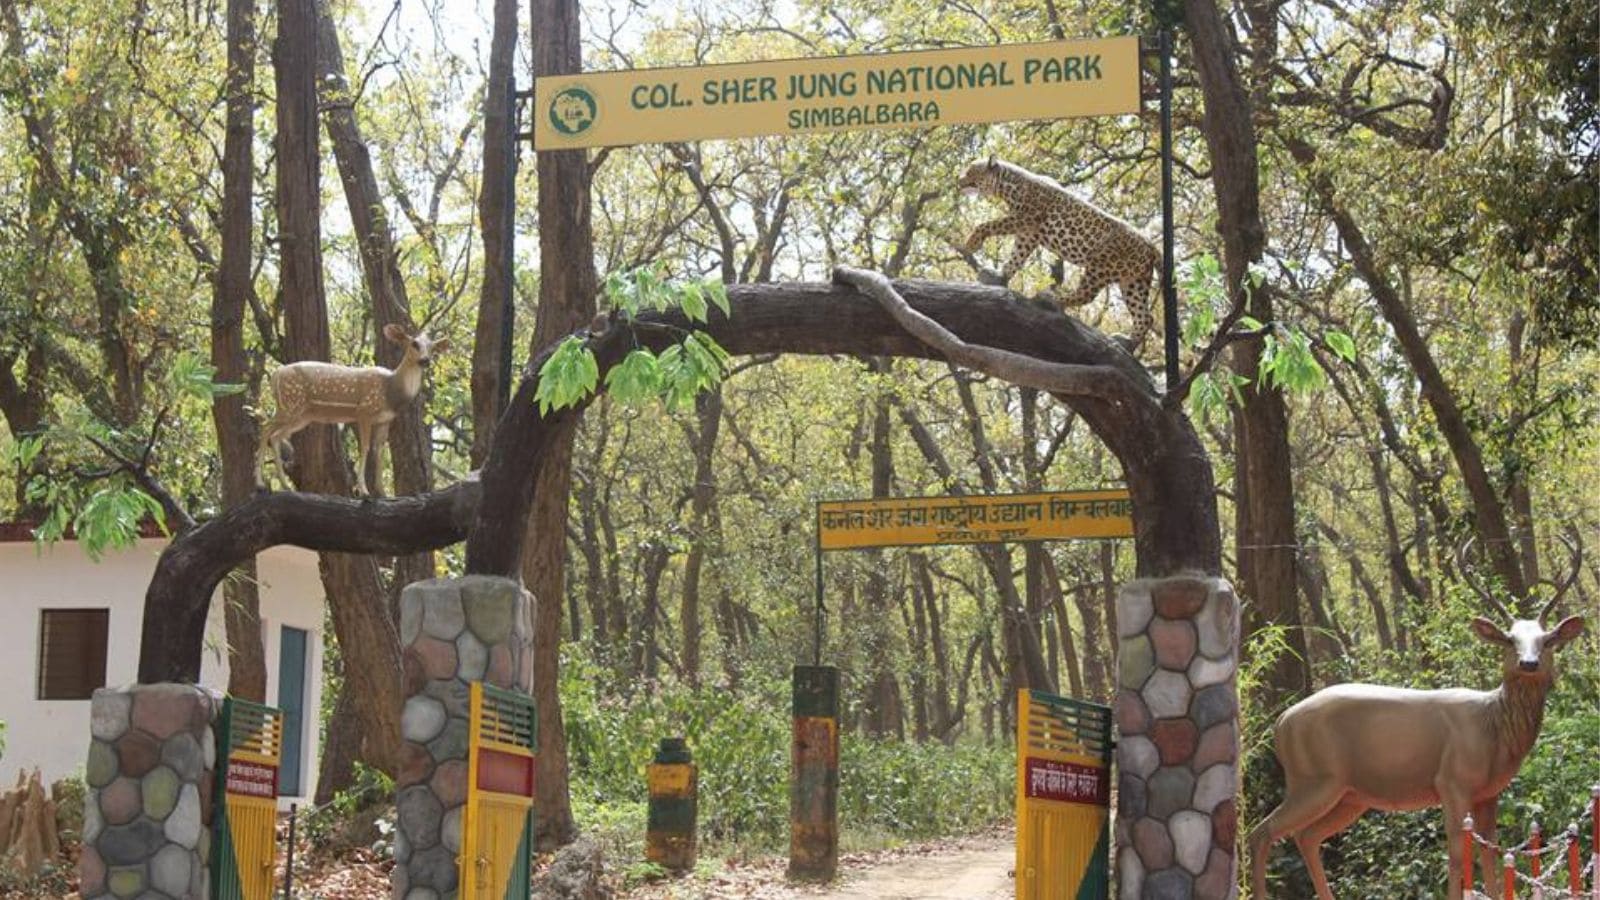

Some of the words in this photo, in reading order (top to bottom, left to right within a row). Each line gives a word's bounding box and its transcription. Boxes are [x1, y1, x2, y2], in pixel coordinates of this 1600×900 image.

[631, 84, 693, 109] COL.
[703, 77, 777, 105] SHER
[786, 71, 857, 100] JUNG
[866, 61, 1014, 95] NATIONAL
[1024, 54, 1102, 84] PARK
[788, 101, 940, 129] SIMBALBARA
[988, 502, 1042, 522] उद्यान
